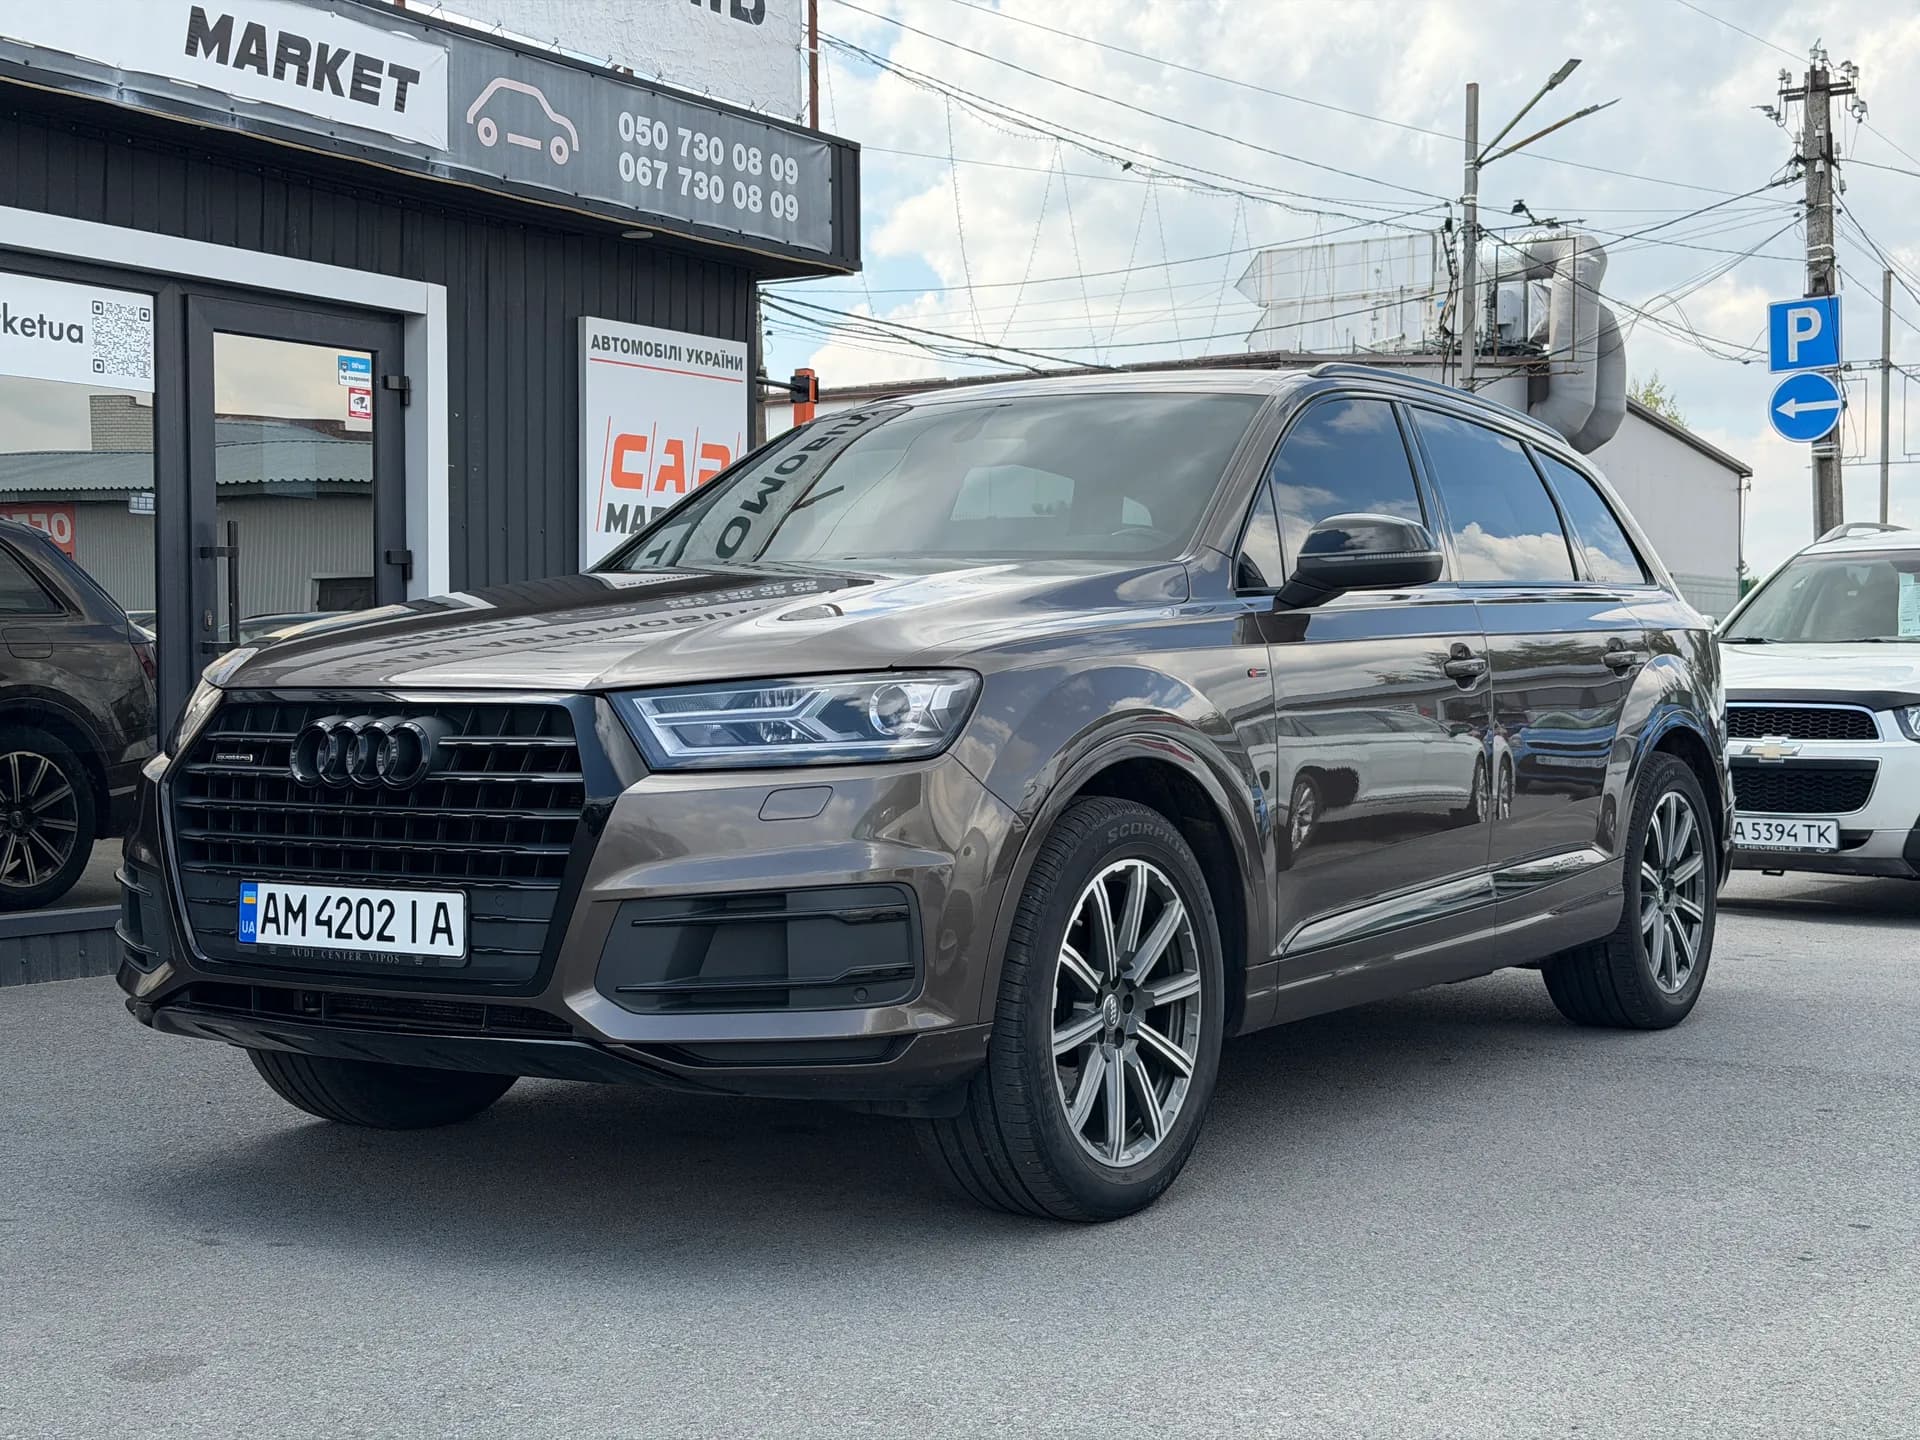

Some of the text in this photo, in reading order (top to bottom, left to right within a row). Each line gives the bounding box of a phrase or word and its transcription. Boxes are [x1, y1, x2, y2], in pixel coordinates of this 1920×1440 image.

[184, 5, 420, 114] MARKET
[618, 111, 798, 185] 050 730 08 09
[618, 152, 798, 222] 067 730 08 09
[0, 302, 83, 344] ketua
[1787, 307, 1822, 363] P
[591, 334, 743, 371] АВТОМОБІЛІ УКРАЇНИ
[1751, 822, 1798, 843] 5394
[1802, 824, 1832, 844] TK
[241, 920, 256, 934] UA
[260, 892, 307, 937] AM
[315, 895, 396, 943] 4202
[321, 949, 361, 961] CENTER
